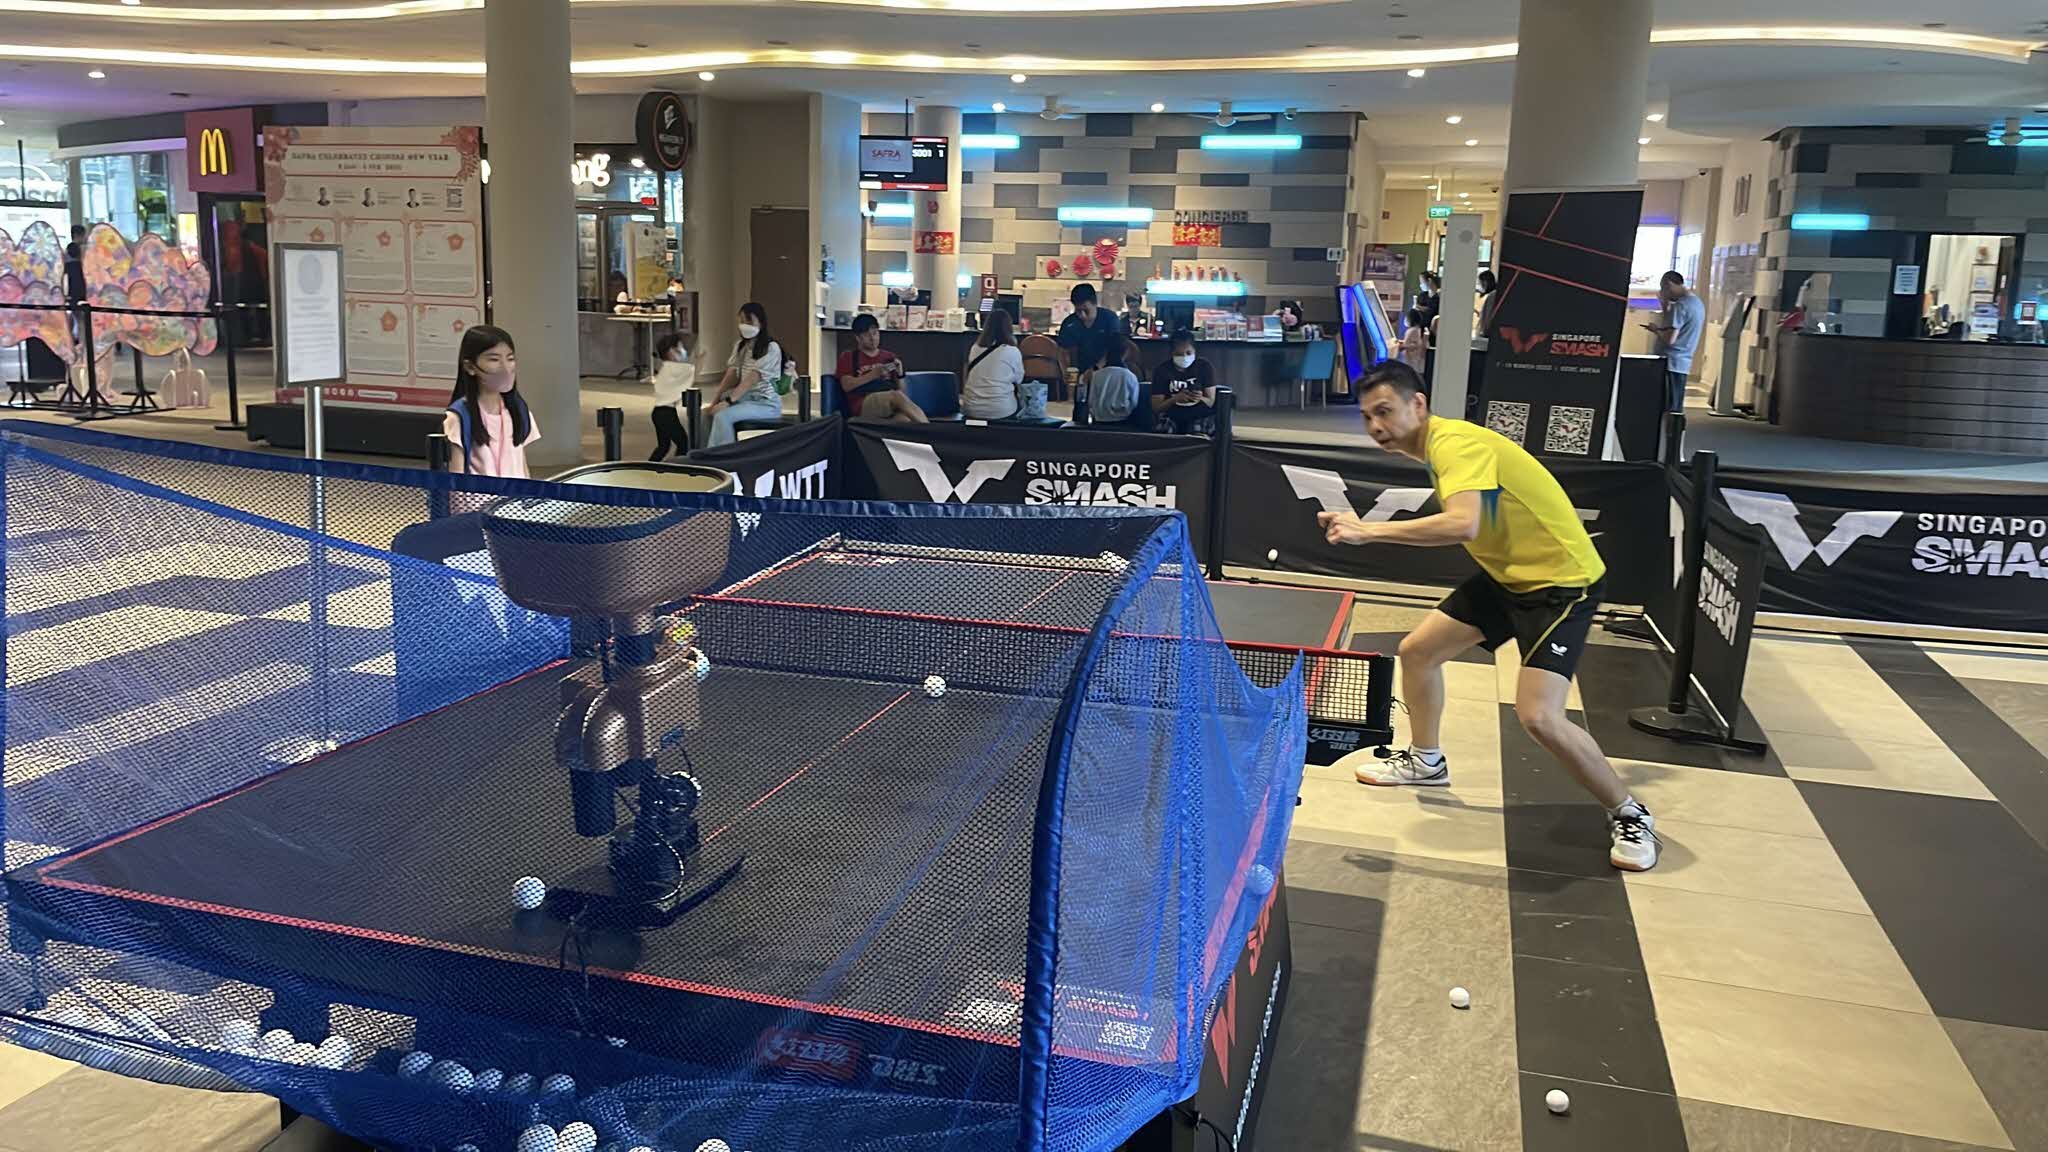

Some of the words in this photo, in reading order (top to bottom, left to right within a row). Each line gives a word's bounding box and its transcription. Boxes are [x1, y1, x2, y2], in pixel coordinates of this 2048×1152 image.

[871, 148, 902, 160] SAFRA
[1549, 341, 1610, 358] SMASH
[1551, 333, 1601, 343] SINGAPORE
[779, 459, 829, 500] WTT
[1026, 460, 1151, 481] SINGAPORE
[1024, 478, 1177, 509] SMASH
[1703, 540, 1739, 588] SINGAPORE
[1911, 535, 2048, 580] SMA
[1697, 566, 1741, 646] SMASH
